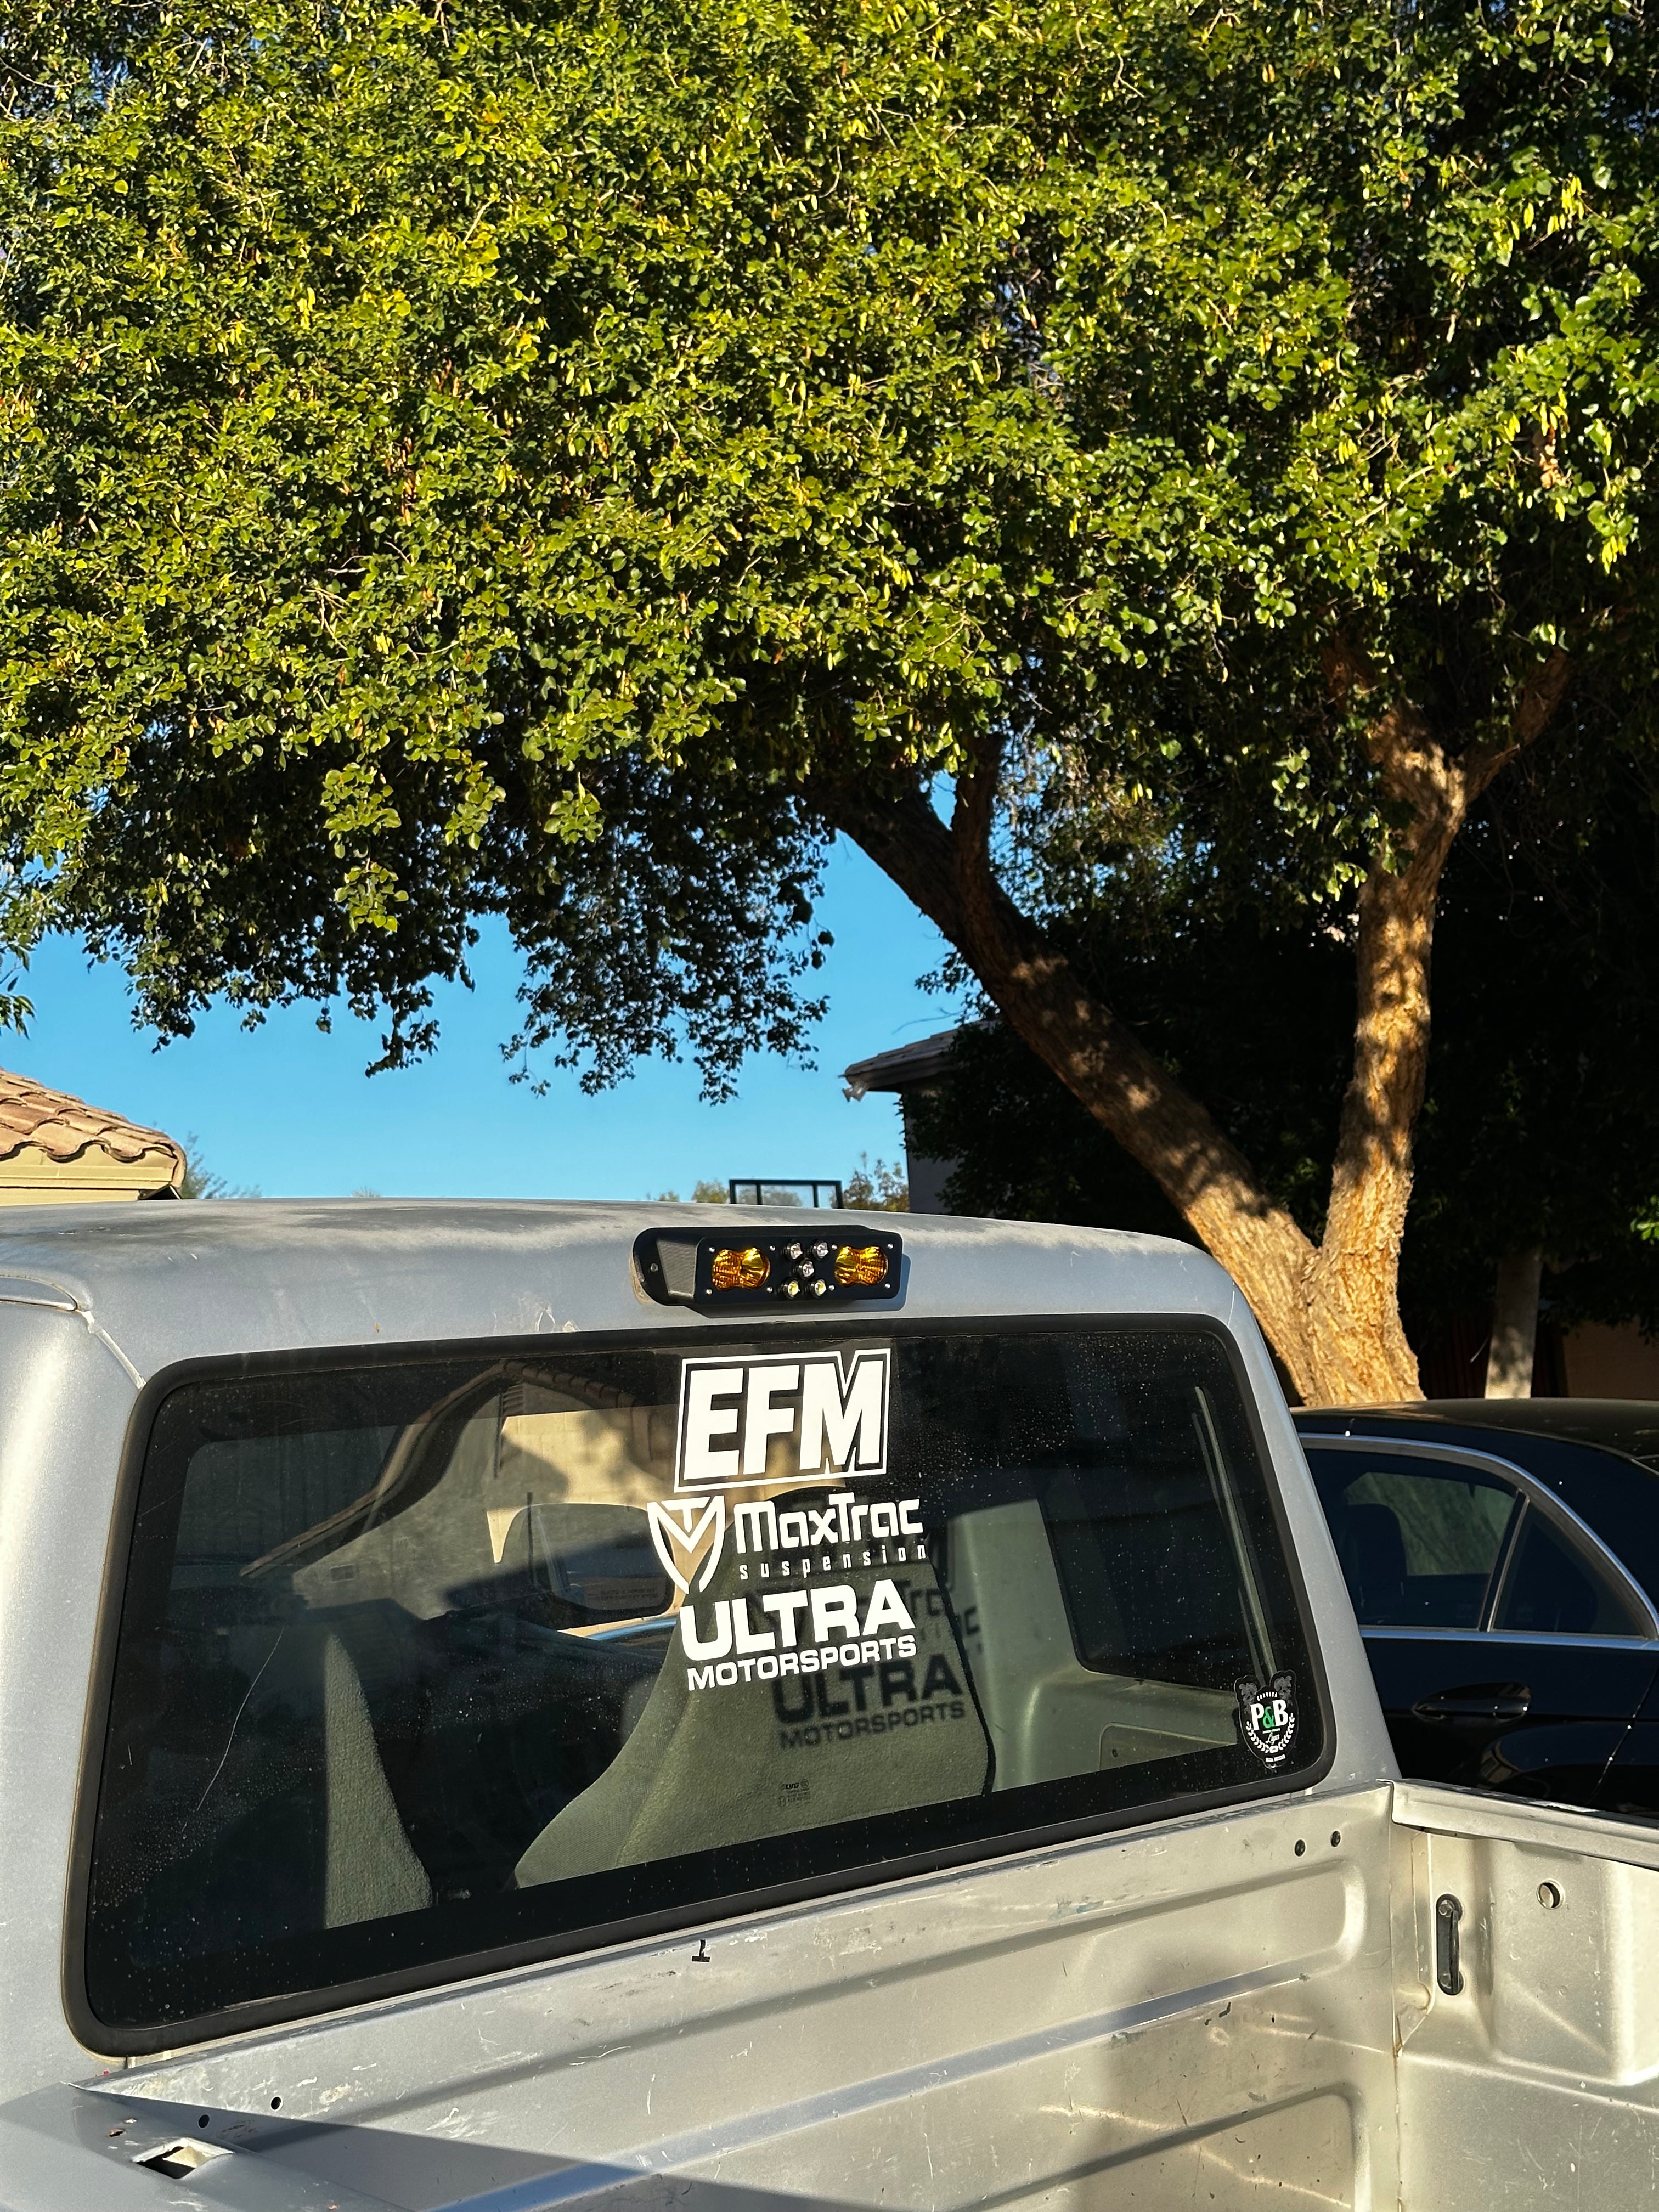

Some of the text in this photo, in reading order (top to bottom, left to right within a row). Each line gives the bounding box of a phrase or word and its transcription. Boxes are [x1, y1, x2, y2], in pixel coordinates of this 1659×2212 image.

[684, 1361, 883, 1480] EFM
[734, 1492, 924, 1554] MaxTrac
[740, 1544, 926, 1580] suspension
[679, 1579, 916, 1661] ULTRA
[687, 1635, 917, 1691] MOTORSPORTS
[1250, 1699, 1289, 1730] P&B
